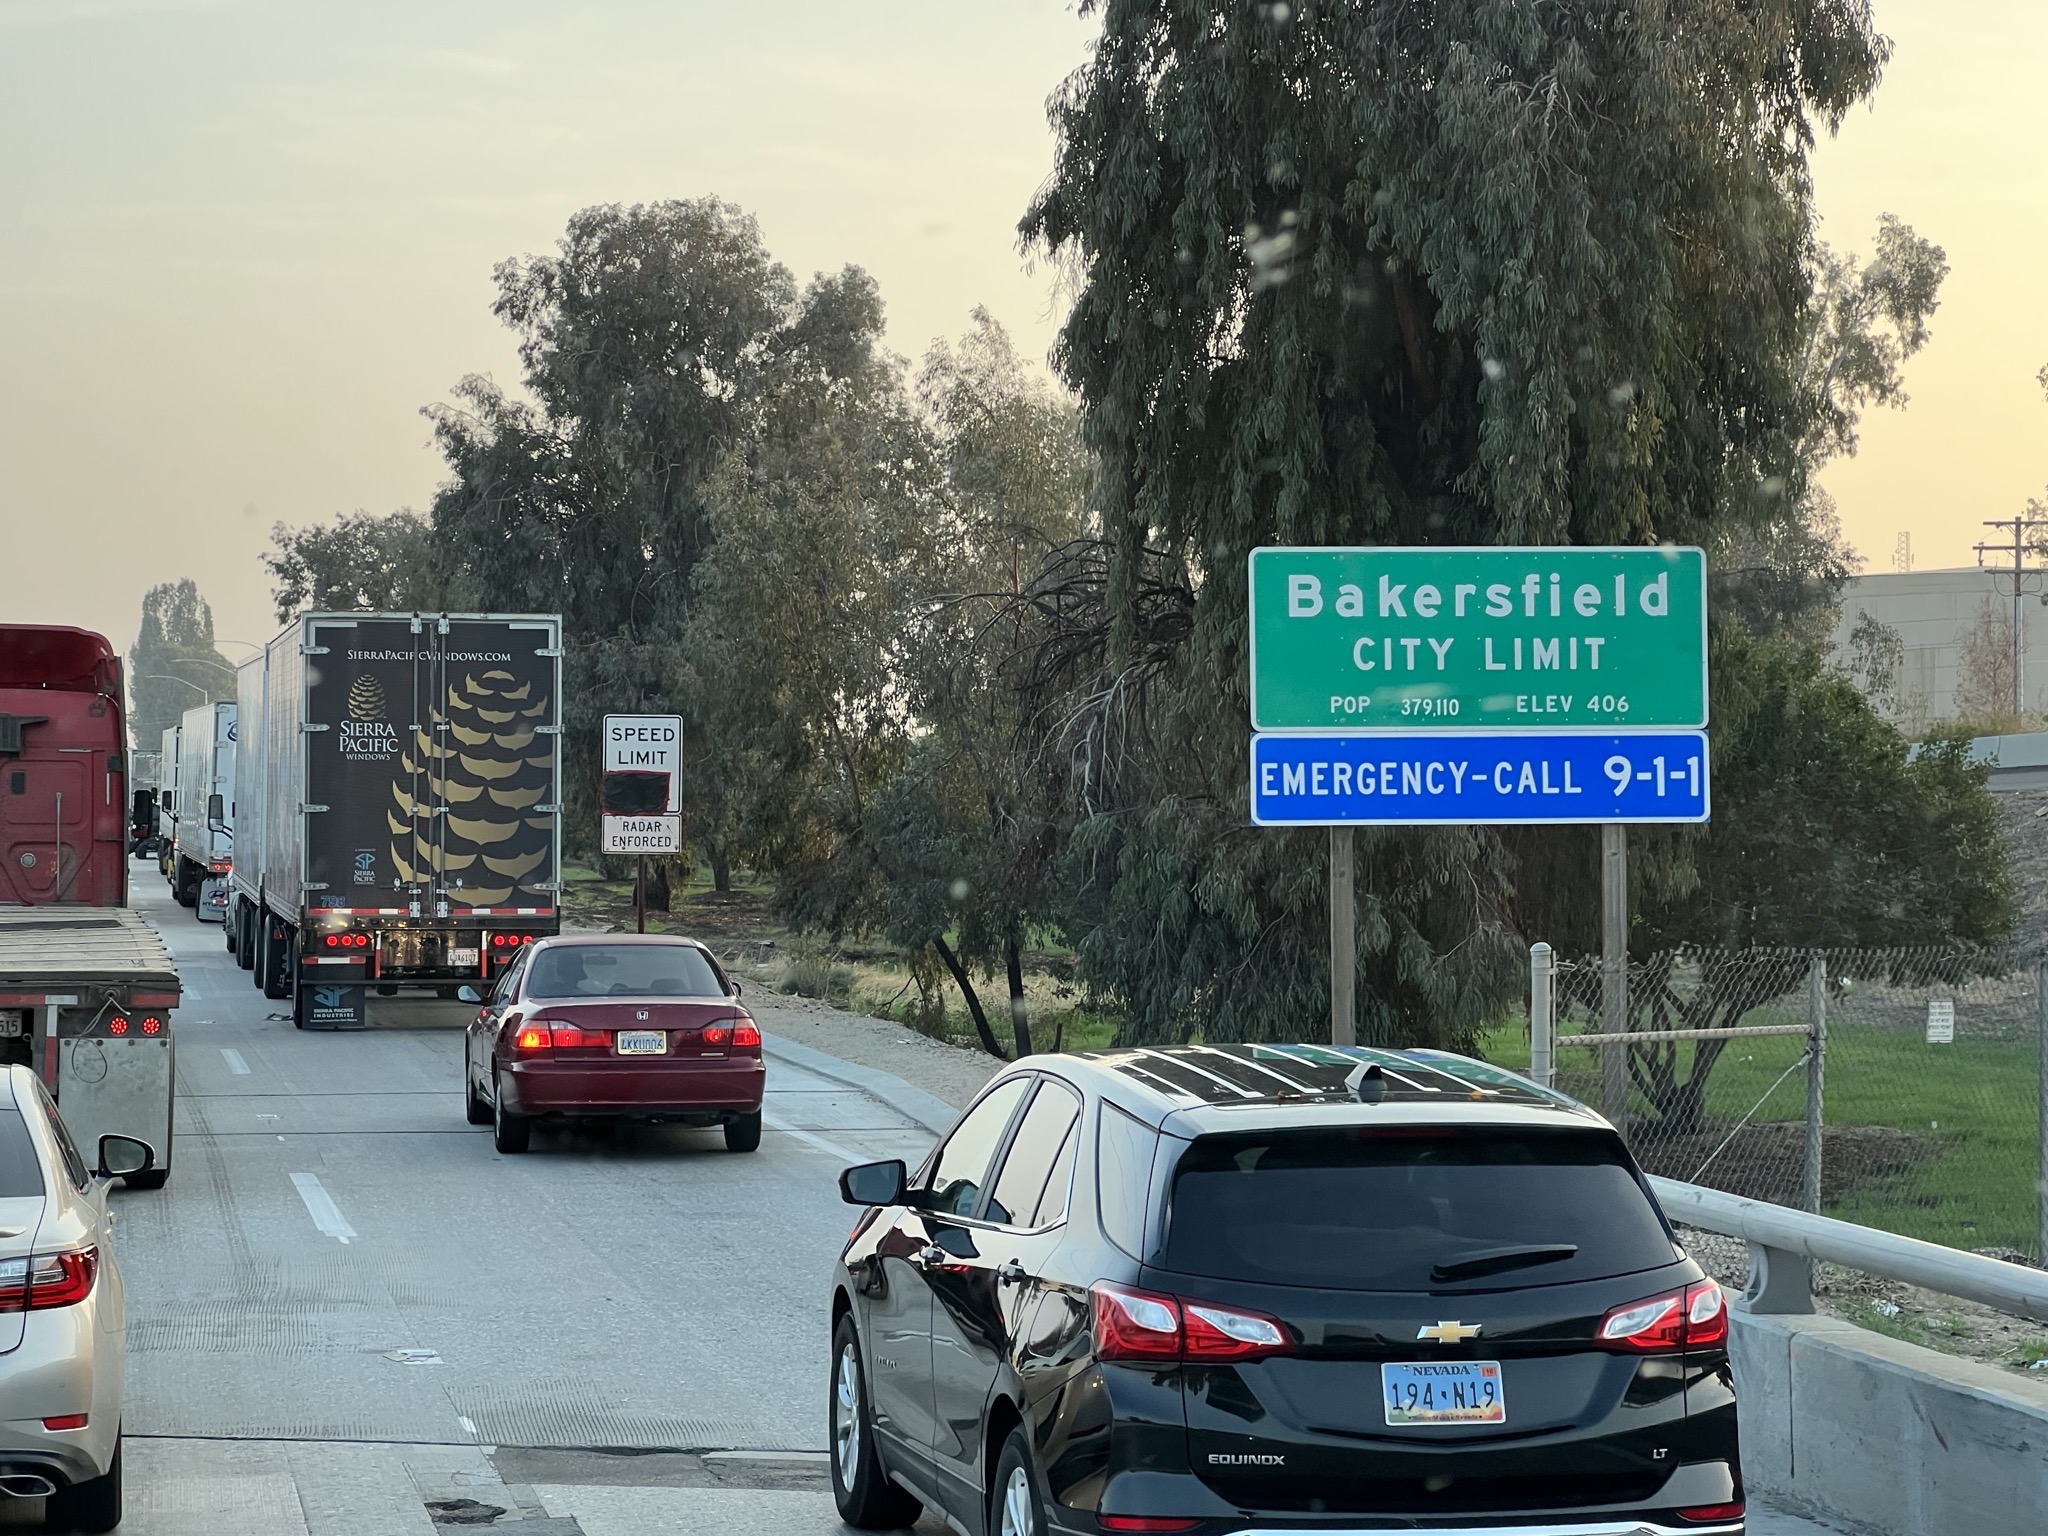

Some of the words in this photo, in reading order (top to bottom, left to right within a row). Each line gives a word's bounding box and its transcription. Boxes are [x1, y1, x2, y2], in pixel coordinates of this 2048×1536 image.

[1288, 571, 1668, 618] Bakersfield
[347, 649, 511, 662] SIERRAPACIFCWINDOWS.COM
[1353, 637, 1455, 671] CITY
[1484, 637, 1605, 671] LIMIT
[1330, 695, 1371, 714] POP
[1400, 698, 1460, 718] 379,110
[1516, 695, 1573, 713] ELEV
[1586, 694, 1630, 713] 406
[339, 720, 396, 737] SIERRA
[611, 727, 675, 742] SPEED
[339, 736, 399, 752] PACIFIC
[346, 753, 391, 761] WINDOWS
[618, 750, 668, 765] LIMIT
[1260, 760, 1583, 796] EMERGENCY-CALL
[1603, 755, 1699, 797] 9-1-1
[622, 820, 662, 833] RADAR
[612, 836, 672, 848] ENFORCED
[320, 895, 346, 908] 798
[1412, 1365, 1471, 1376] NEVADA
[1208, 1453, 1285, 1466] EQUINOX
[1653, 1448, 1669, 1460] LT
